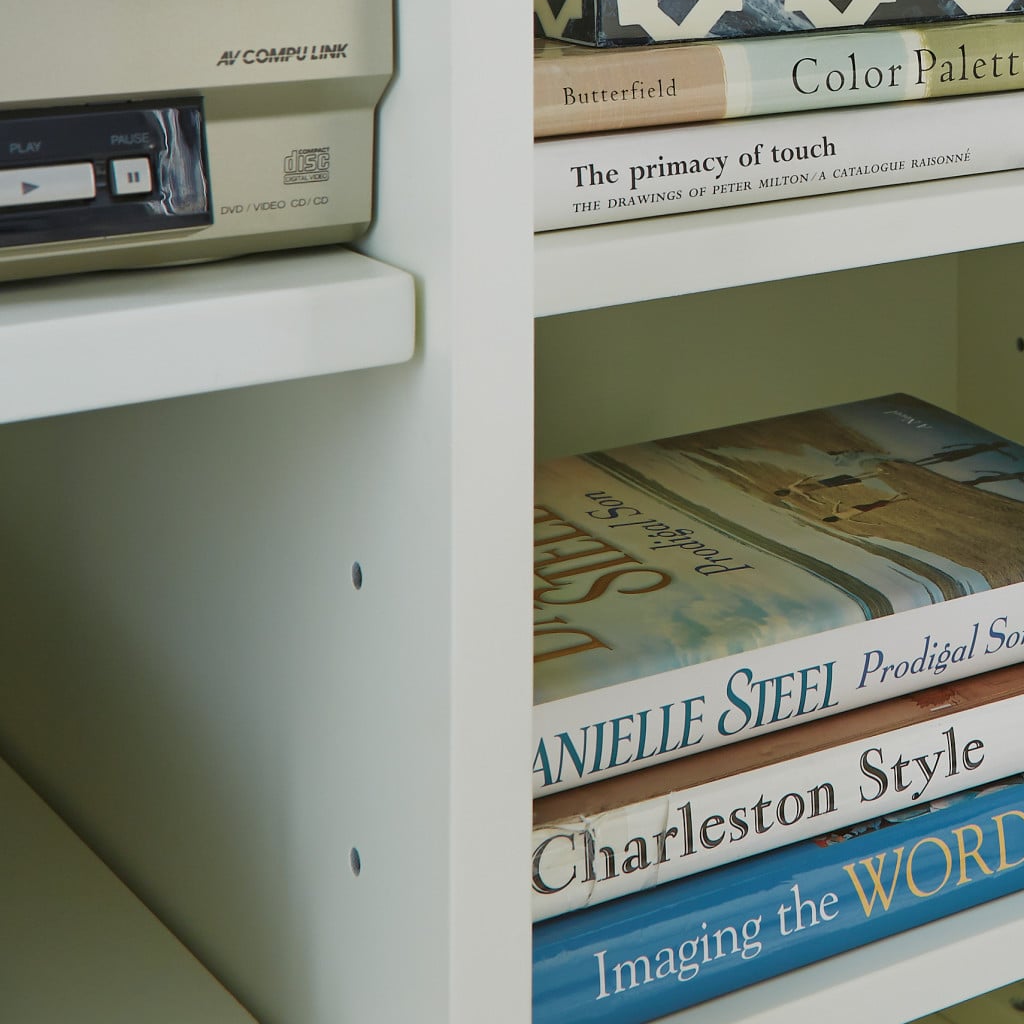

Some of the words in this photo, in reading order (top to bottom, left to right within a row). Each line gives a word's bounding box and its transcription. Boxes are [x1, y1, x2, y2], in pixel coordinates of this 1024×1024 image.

[216, 50, 240, 66] AV
[792, 52, 902, 94] Color
[563, 78, 677, 105] Butterfield
[9, 141, 42, 153] PLAY
[110, 132, 149, 145] PAUSE
[571, 164, 619, 188] The
[630, 156, 728, 190] primacy
[739, 144, 763, 167] of
[771, 136, 837, 163] touch
[573, 201, 600, 213] THE
[608, 190, 682, 209] DRAWINGS
[689, 187, 706, 198] OF
[713, 181, 752, 195] PETER
[833, 161, 905, 179] CATALOGUE
[911, 148, 971, 169] RAISONNÉ
[220, 205, 243, 215] DVD
[254, 200, 286, 212] VIDEO
[585, 491, 643, 519] Son
[608, 518, 755, 576] Prodigal
[533, 695, 705, 788] ANIELLE
[718, 661, 840, 736] STEEL
[856, 623, 978, 689] Prodigal
[532, 782, 837, 894] Charleston
[860, 726, 985, 802] Style
[594, 915, 763, 1000] Imaging
[777, 884, 840, 937] the
